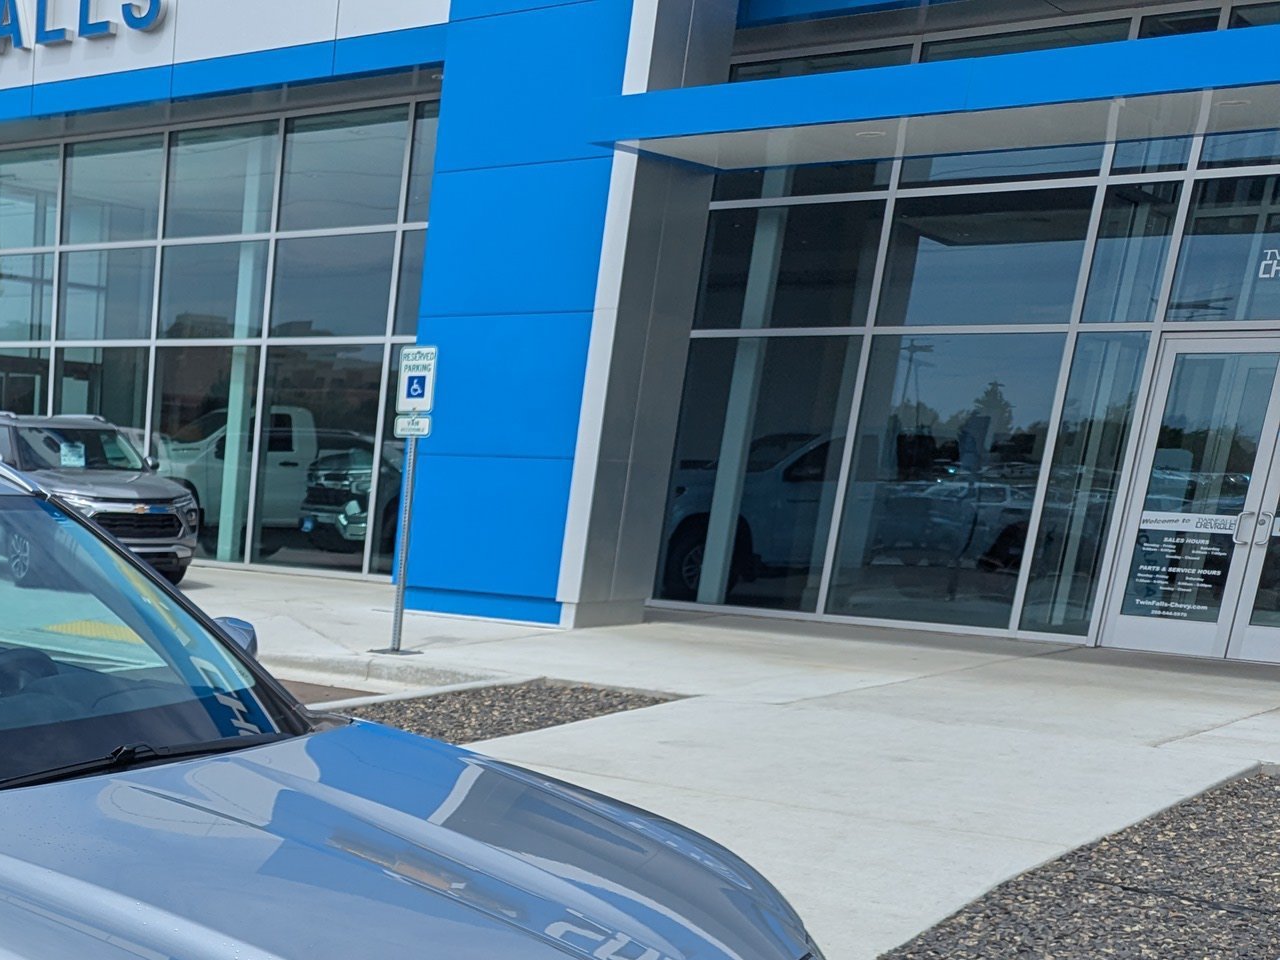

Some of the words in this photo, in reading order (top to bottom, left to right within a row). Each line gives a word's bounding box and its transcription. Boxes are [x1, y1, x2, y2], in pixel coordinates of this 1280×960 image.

[402, 352, 435, 361] RESERVED
[403, 363, 432, 373] PARKING
[1142, 517, 1180, 526] Welcome
[1163, 536, 1186, 544] SALES
[1186, 537, 1210, 546] HOURS
[1168, 567, 1197, 575] SERVICE
[1135, 598, 1208, 611] TwinFalls-Chevy.com
